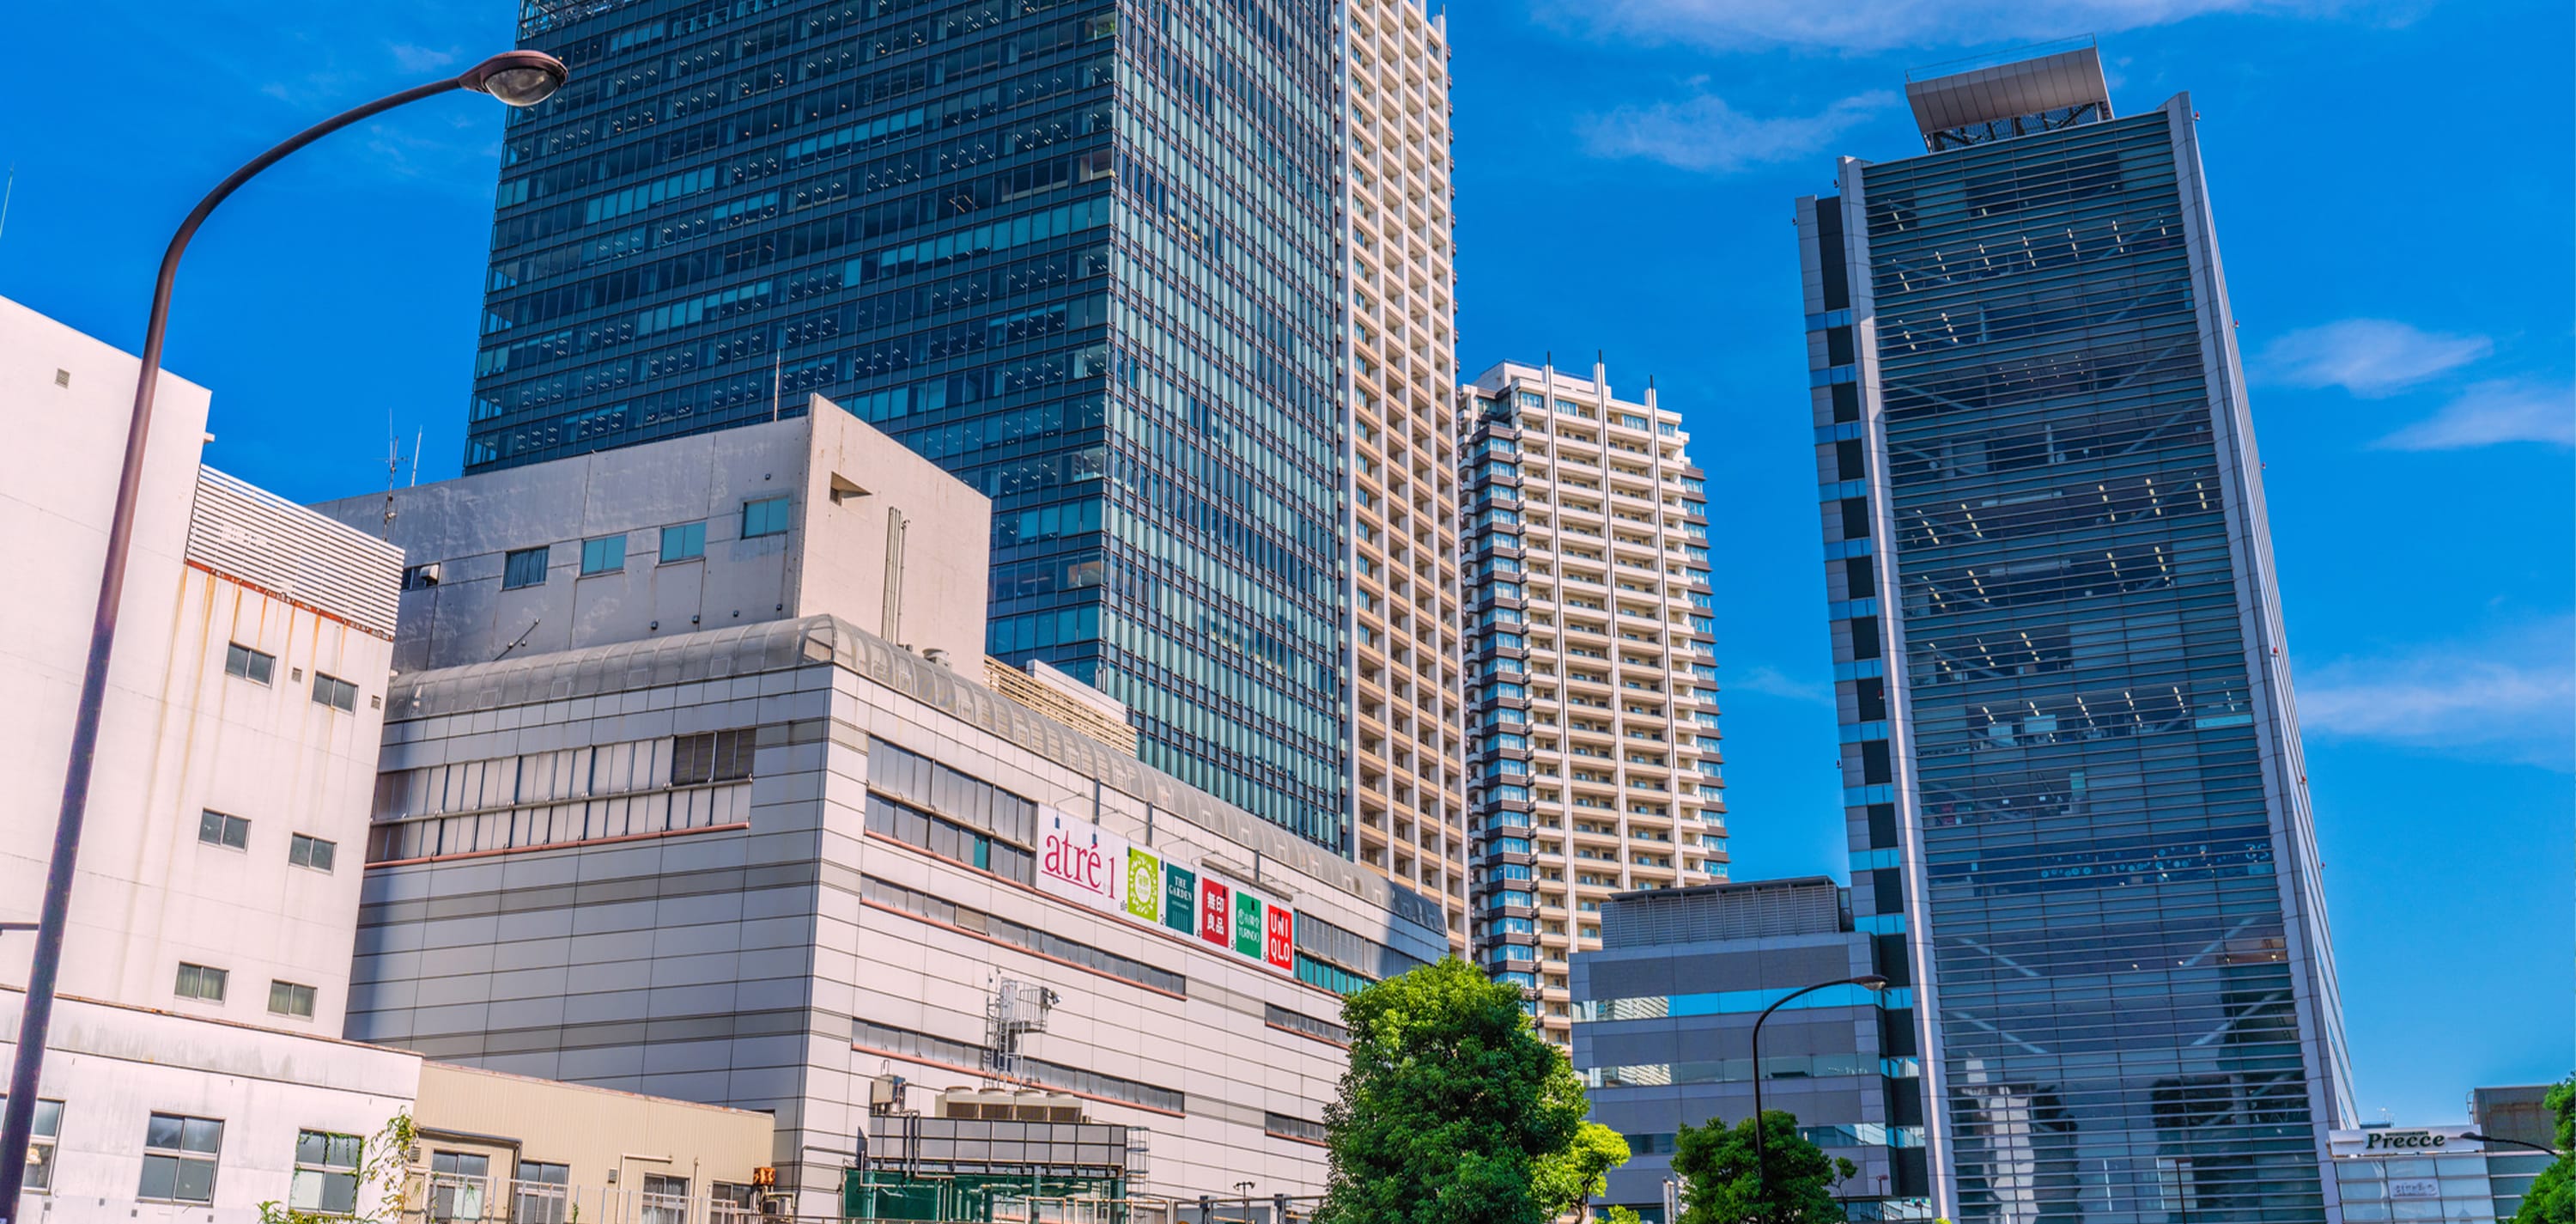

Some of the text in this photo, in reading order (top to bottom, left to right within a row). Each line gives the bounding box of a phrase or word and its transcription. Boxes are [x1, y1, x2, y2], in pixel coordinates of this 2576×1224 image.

[1044, 830, 1116, 900] atré 1
[1168, 884, 1193, 902] GARDEN
[1174, 875, 1188, 890] THE
[1207, 890, 1224, 913] 無印
[1206, 912, 1224, 935] 良品
[1271, 911, 1289, 938] UNI
[1271, 937, 1291, 963] QLO
[2366, 1132, 2445, 1150] Precce
